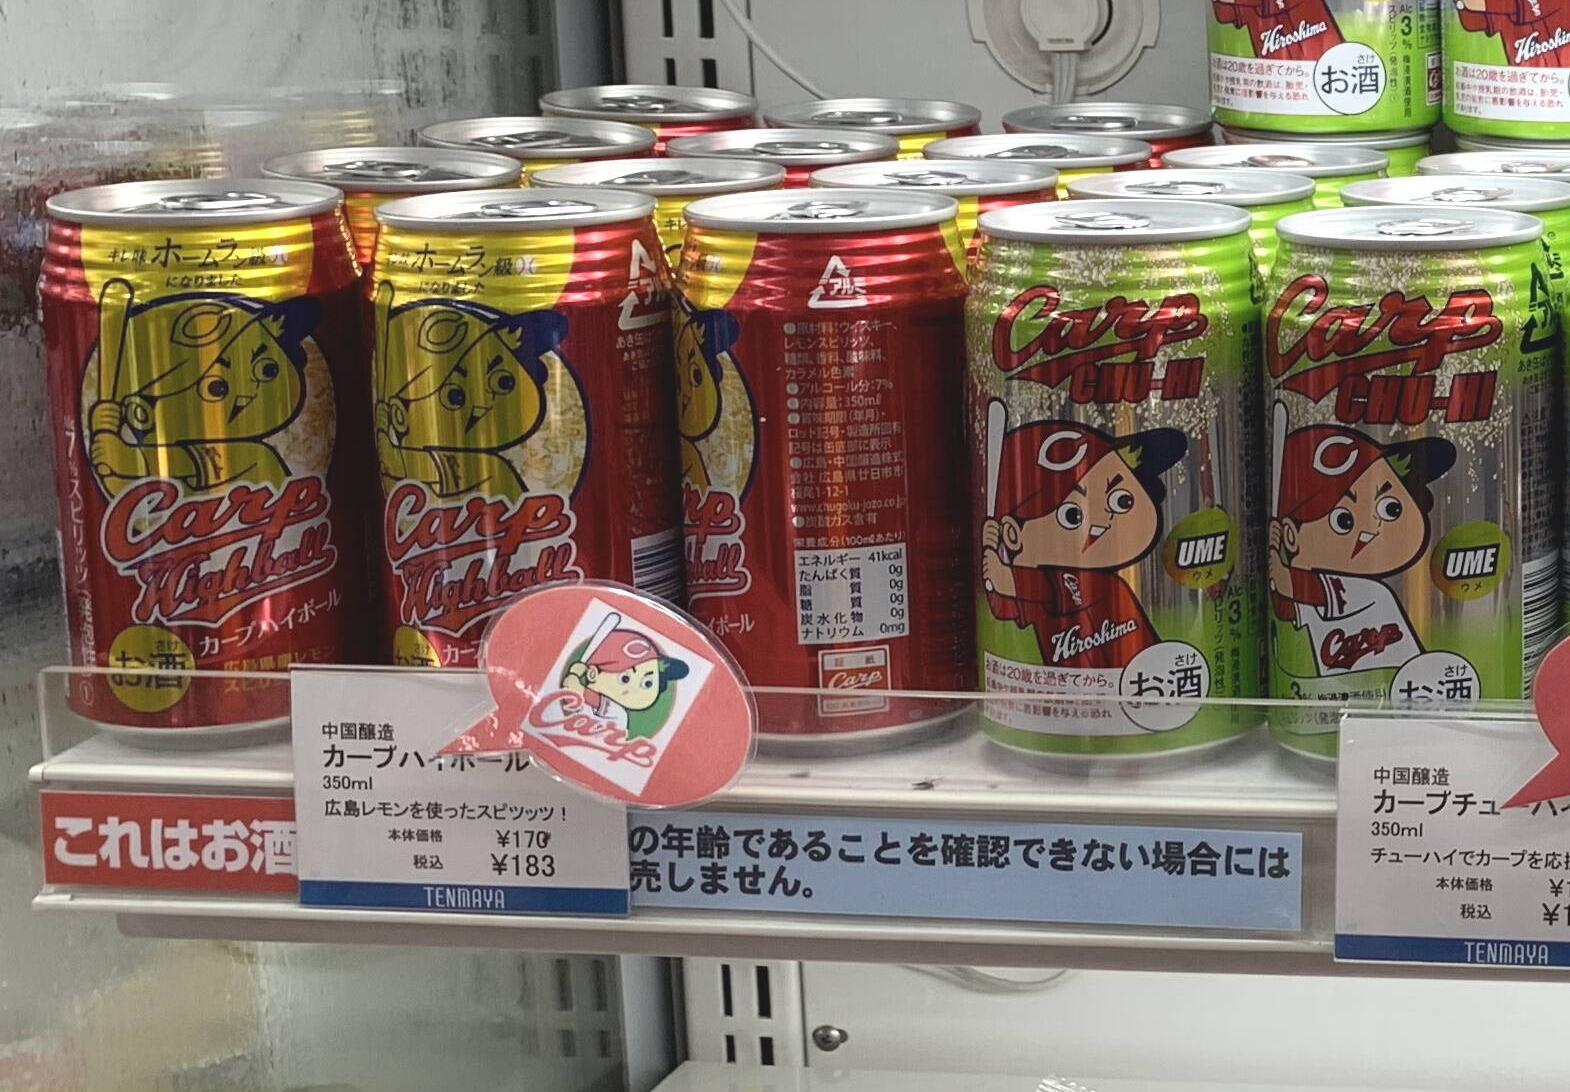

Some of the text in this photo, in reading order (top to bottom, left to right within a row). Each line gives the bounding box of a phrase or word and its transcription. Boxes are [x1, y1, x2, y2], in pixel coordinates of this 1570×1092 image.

[1261, 21, 1327, 56] Hiroshima
[1321, 65, 1379, 95] お酒
[992, 285, 1208, 382] Carp
[1265, 274, 1502, 401] Carp
[1071, 358, 1205, 404] CHU-HI
[1334, 371, 1498, 424] CHU-HI
[105, 476, 328, 568] Carp
[386, 485, 572, 568] Carp
[799, 548, 902, 567] エネルギー 41kcal
[1177, 535, 1226, 567] UME
[1446, 545, 1497, 579] UME
[800, 567, 861, 581] たんぱく質
[801, 626, 864, 640] ナトリウム
[1052, 616, 1137, 664] Hiroshima
[114, 651, 186, 691] お酒
[322, 722, 395, 741] 中国醸造
[529, 689, 661, 768] Carp
[323, 776, 373, 790] 350ml
[1373, 766, 1450, 786] 中国醸造
[388, 829, 443, 843] 本体価格
[1371, 822, 1423, 838] 350ml
[413, 853, 556, 877] 税込 ¥183
[629, 824, 1291, 880] の年齢であることを確認できない場合には
[424, 886, 505, 909] TENMAYA
[1435, 877, 1493, 892] 本体価格
[1460, 904, 1492, 920] 税込
[1464, 941, 1549, 965] TENMAYA
